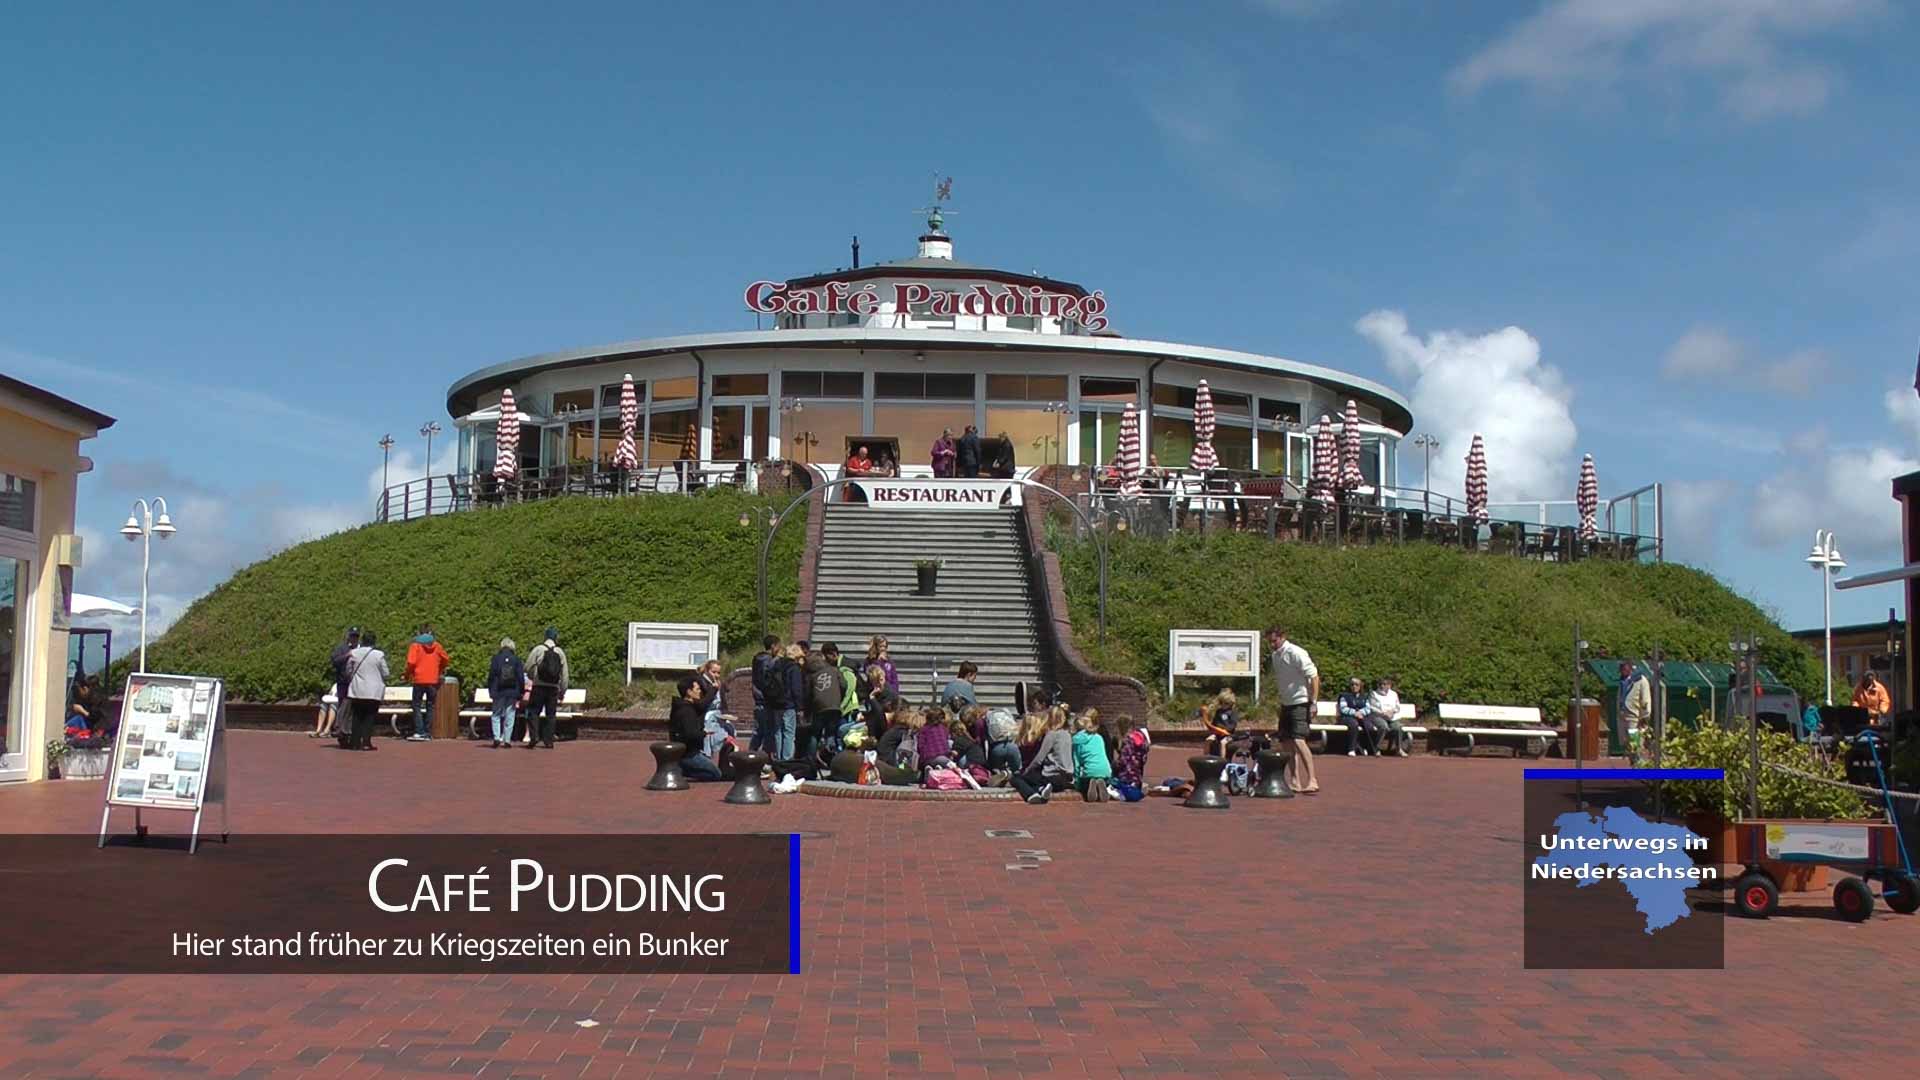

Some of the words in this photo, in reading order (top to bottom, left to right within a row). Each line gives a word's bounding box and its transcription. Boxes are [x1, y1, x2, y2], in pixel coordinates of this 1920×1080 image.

[744, 280, 881, 315] Café
[892, 283, 1109, 332] Pudding
[874, 487, 996, 503] RESTAURANT
